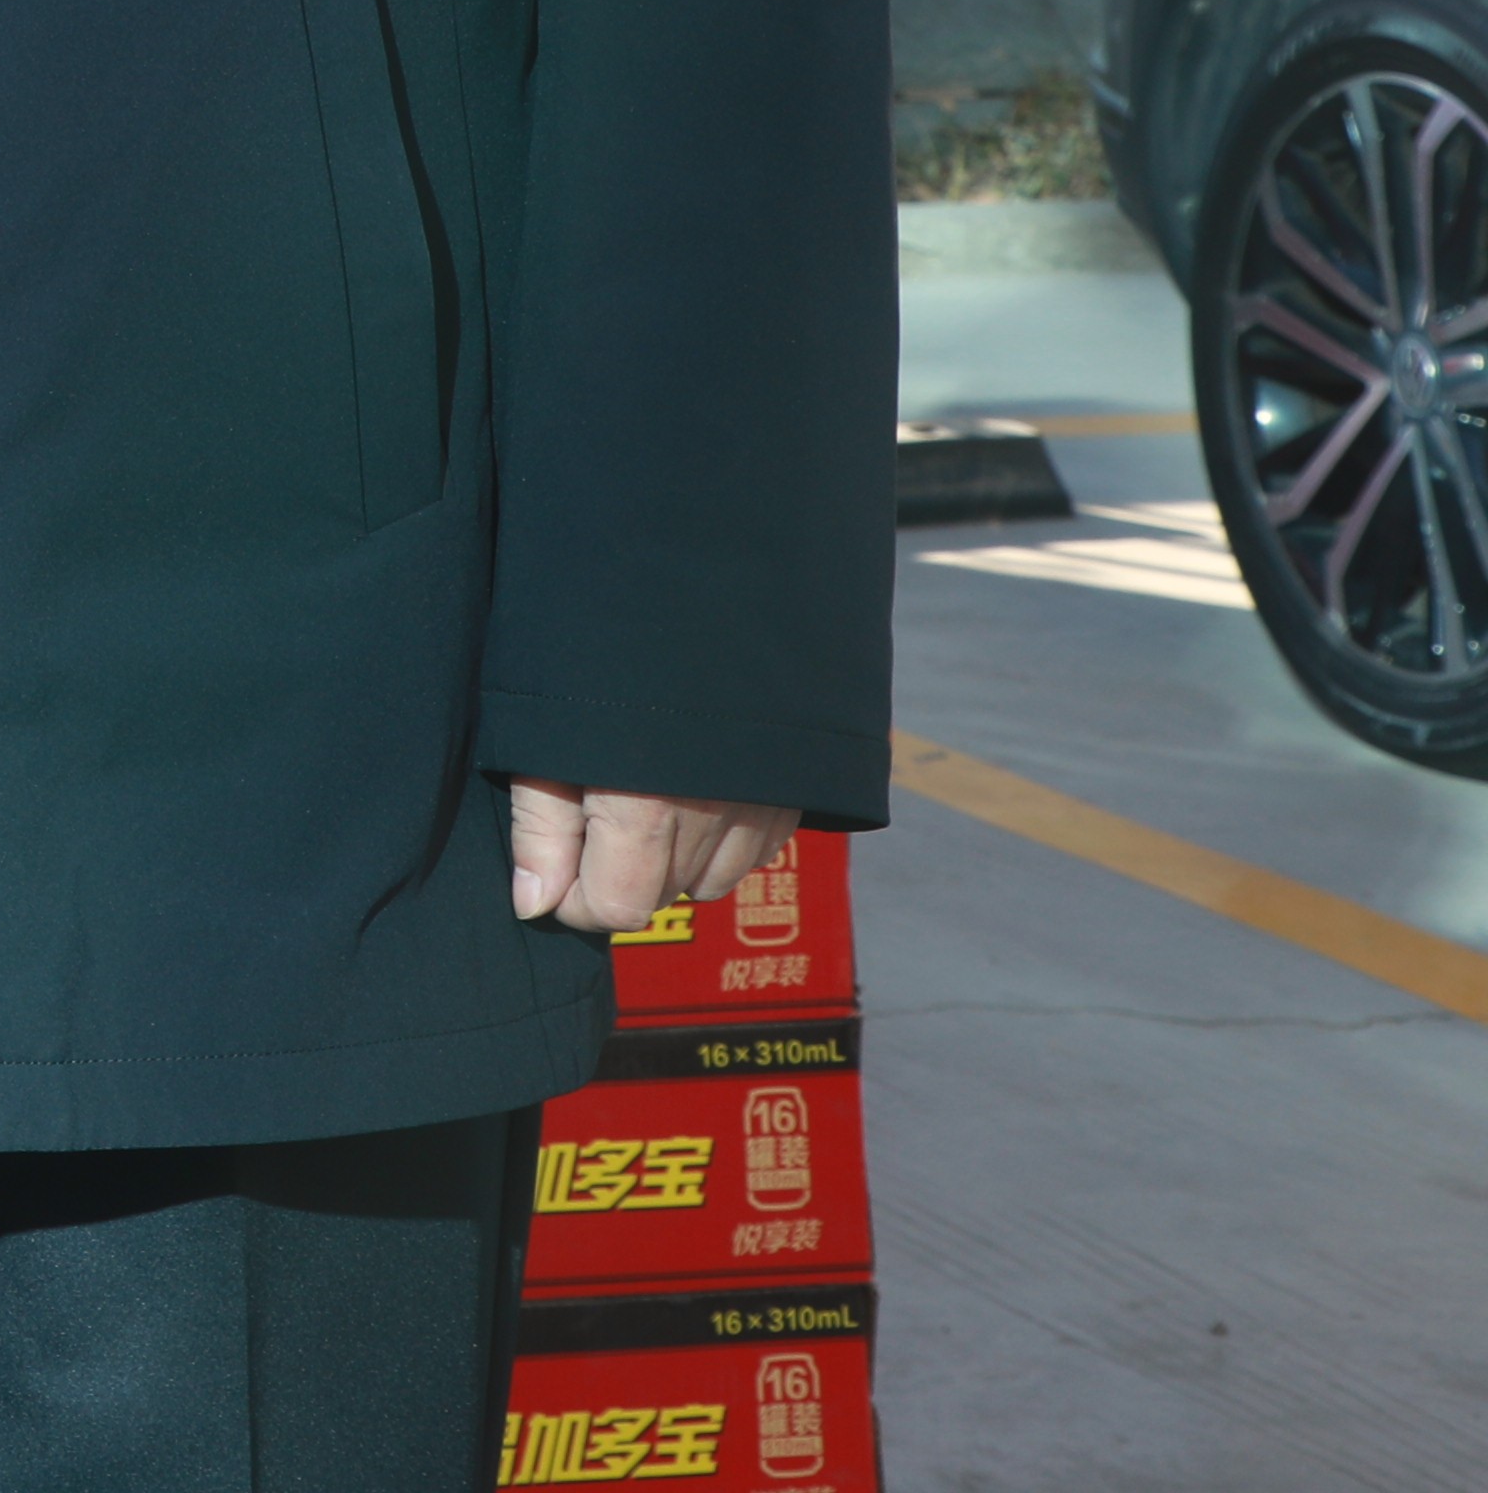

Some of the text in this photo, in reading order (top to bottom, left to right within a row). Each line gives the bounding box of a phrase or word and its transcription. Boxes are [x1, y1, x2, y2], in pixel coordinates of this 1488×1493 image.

[752, 1099, 797, 1134] 16
[764, 1365, 810, 1401] 16
[497, 1403, 726, 1486] 加多宝
